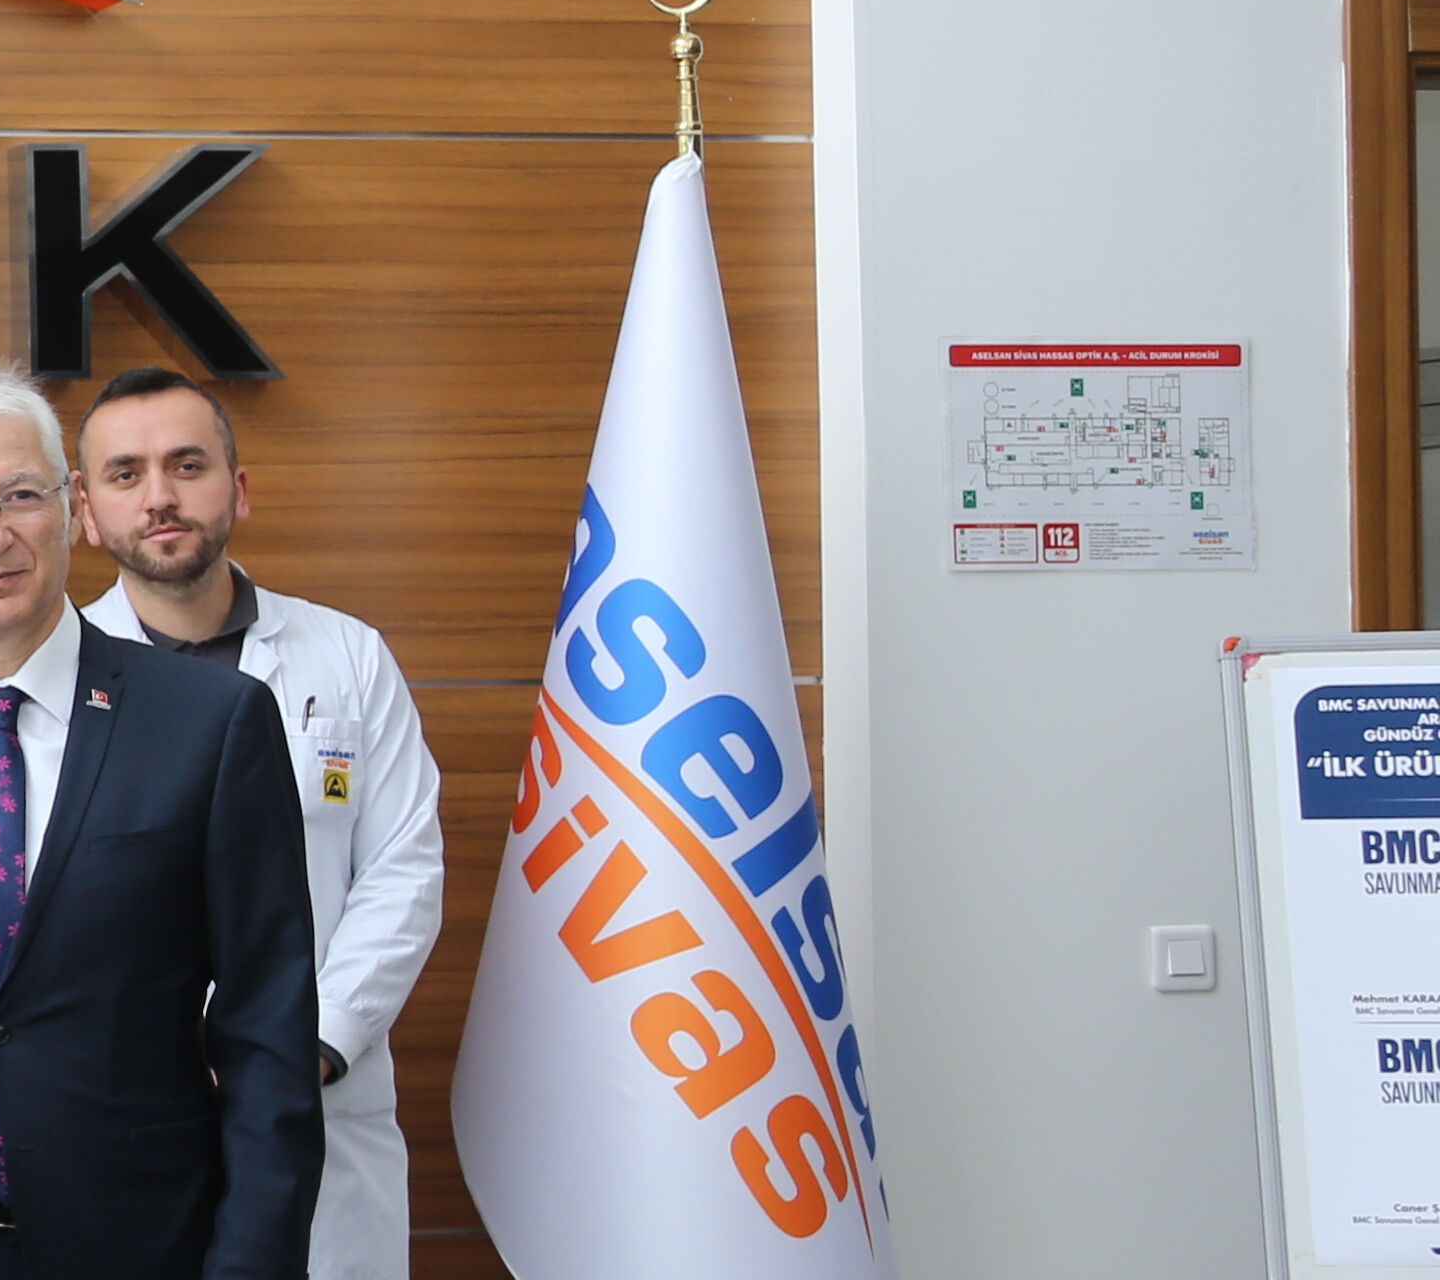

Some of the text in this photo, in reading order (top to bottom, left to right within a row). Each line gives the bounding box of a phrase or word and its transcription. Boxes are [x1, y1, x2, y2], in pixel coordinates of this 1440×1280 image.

[971, 352, 1012, 360] ASELSAN
[1013, 350, 1038, 360] SİVAS
[1039, 351, 1074, 360] HASSAS
[1075, 350, 1101, 360] OPTİK
[1128, 350, 1148, 360] ACİL
[1149, 351, 1182, 360] DURUM
[1183, 350, 1220, 359] KROKİSİ
[1047, 527, 1075, 547] 112
[1317, 697, 1440, 712] BMC SAVUNMA
[1363, 726, 1434, 742] GÜNDÜZ
[1361, 829, 1440, 865] BMC
[512, 704, 848, 1238] sivas
[1352, 993, 1399, 1003] Mehmet
[1355, 1007, 1374, 1015] BMC
[1376, 1007, 1414, 1015] Savunma
[1377, 1038, 1440, 1074] BM
[1393, 1203, 1429, 1213] Caner
[1352, 1215, 1372, 1224] BMC
[1374, 1215, 1413, 1224] Savunma
